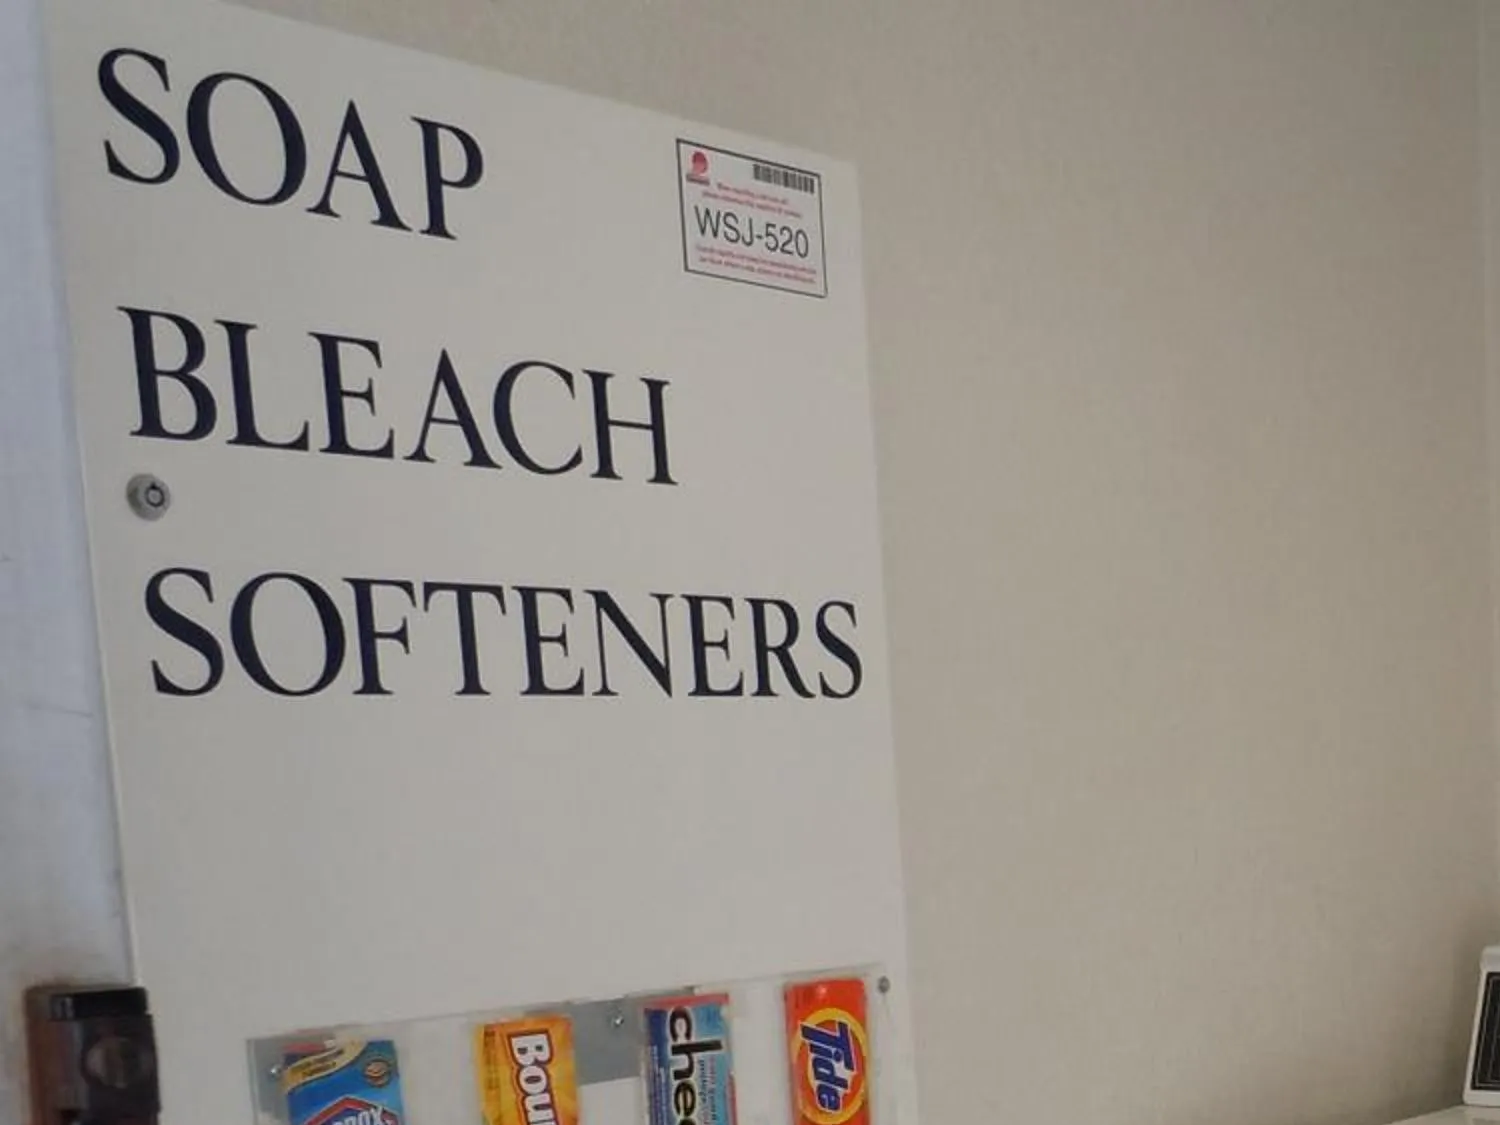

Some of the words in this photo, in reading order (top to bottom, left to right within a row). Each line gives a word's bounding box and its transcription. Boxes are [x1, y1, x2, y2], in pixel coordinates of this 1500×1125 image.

[97, 47, 485, 241] SOAP
[694, 204, 809, 259] WSJ-520
[117, 305, 679, 486] BLEACH
[143, 566, 864, 700] SOFTENERS
[799, 1018, 857, 1113] Tide
